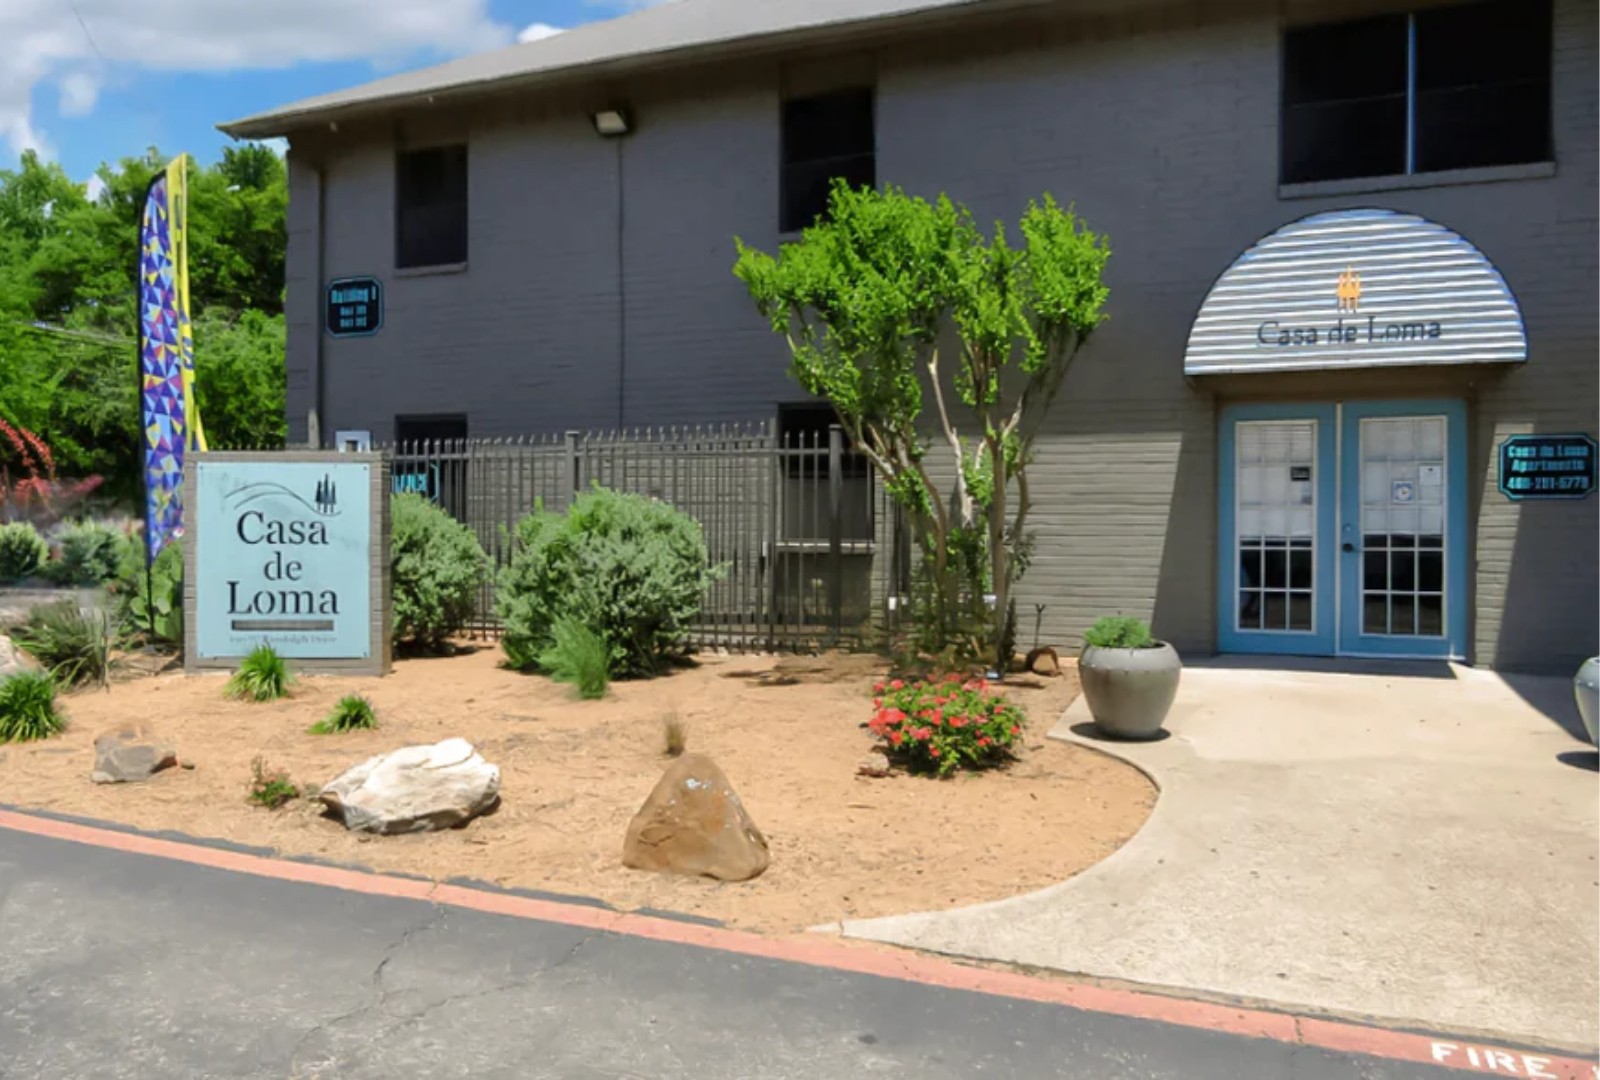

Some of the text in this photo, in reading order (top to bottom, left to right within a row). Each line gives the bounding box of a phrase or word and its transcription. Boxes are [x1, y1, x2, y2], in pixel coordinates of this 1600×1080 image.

[1257, 315, 1442, 346] Casa de Loma
[1507, 445, 1537, 458] Casa
[1511, 459, 1586, 472] Apartments
[237, 510, 329, 545] Casa
[264, 551, 303, 581] de
[227, 580, 340, 615] Loma
[1431, 1041, 1559, 1080] FIRE
